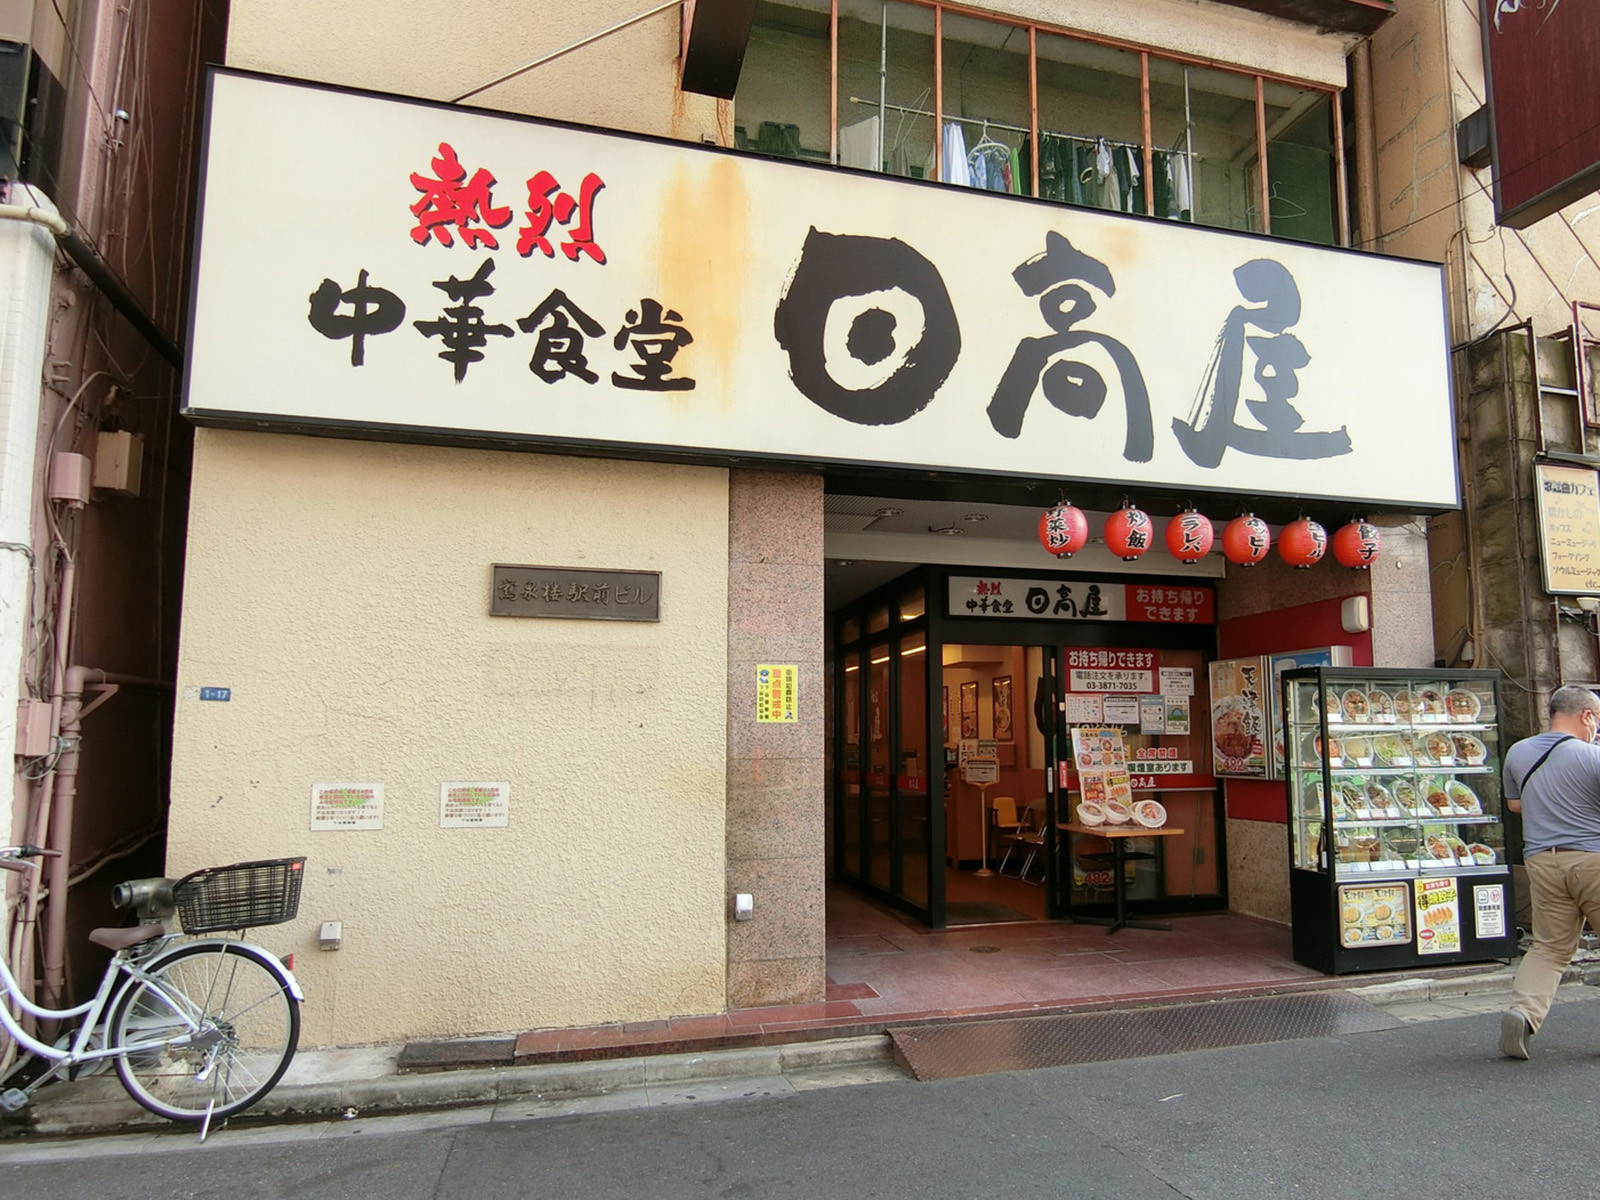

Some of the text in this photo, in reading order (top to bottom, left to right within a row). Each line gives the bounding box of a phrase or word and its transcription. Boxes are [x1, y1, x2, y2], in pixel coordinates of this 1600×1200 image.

[409, 142, 609, 267] 熱烈
[307, 257, 697, 393] 中華食堂
[773, 224, 1354, 470] 日高屋
[1126, 509, 1148, 549] 炒飯
[1358, 524, 1382, 561] 餃子
[965, 596, 1015, 614] 中華食堂
[1025, 583, 1108, 618] 日高屋
[1136, 588, 1204, 605] お持ち帰り
[1144, 605, 1199, 622] できます
[1068, 650, 1155, 668] お持ち帰りできます
[204, 690, 228, 699] 1-17
[1086, 681, 1138, 690] 03-3871-7035
[1240, 665, 1260, 737] 天津飯
[1136, 748, 1178, 759] 全席禁煙
[1131, 777, 1156, 788] 日高屋
